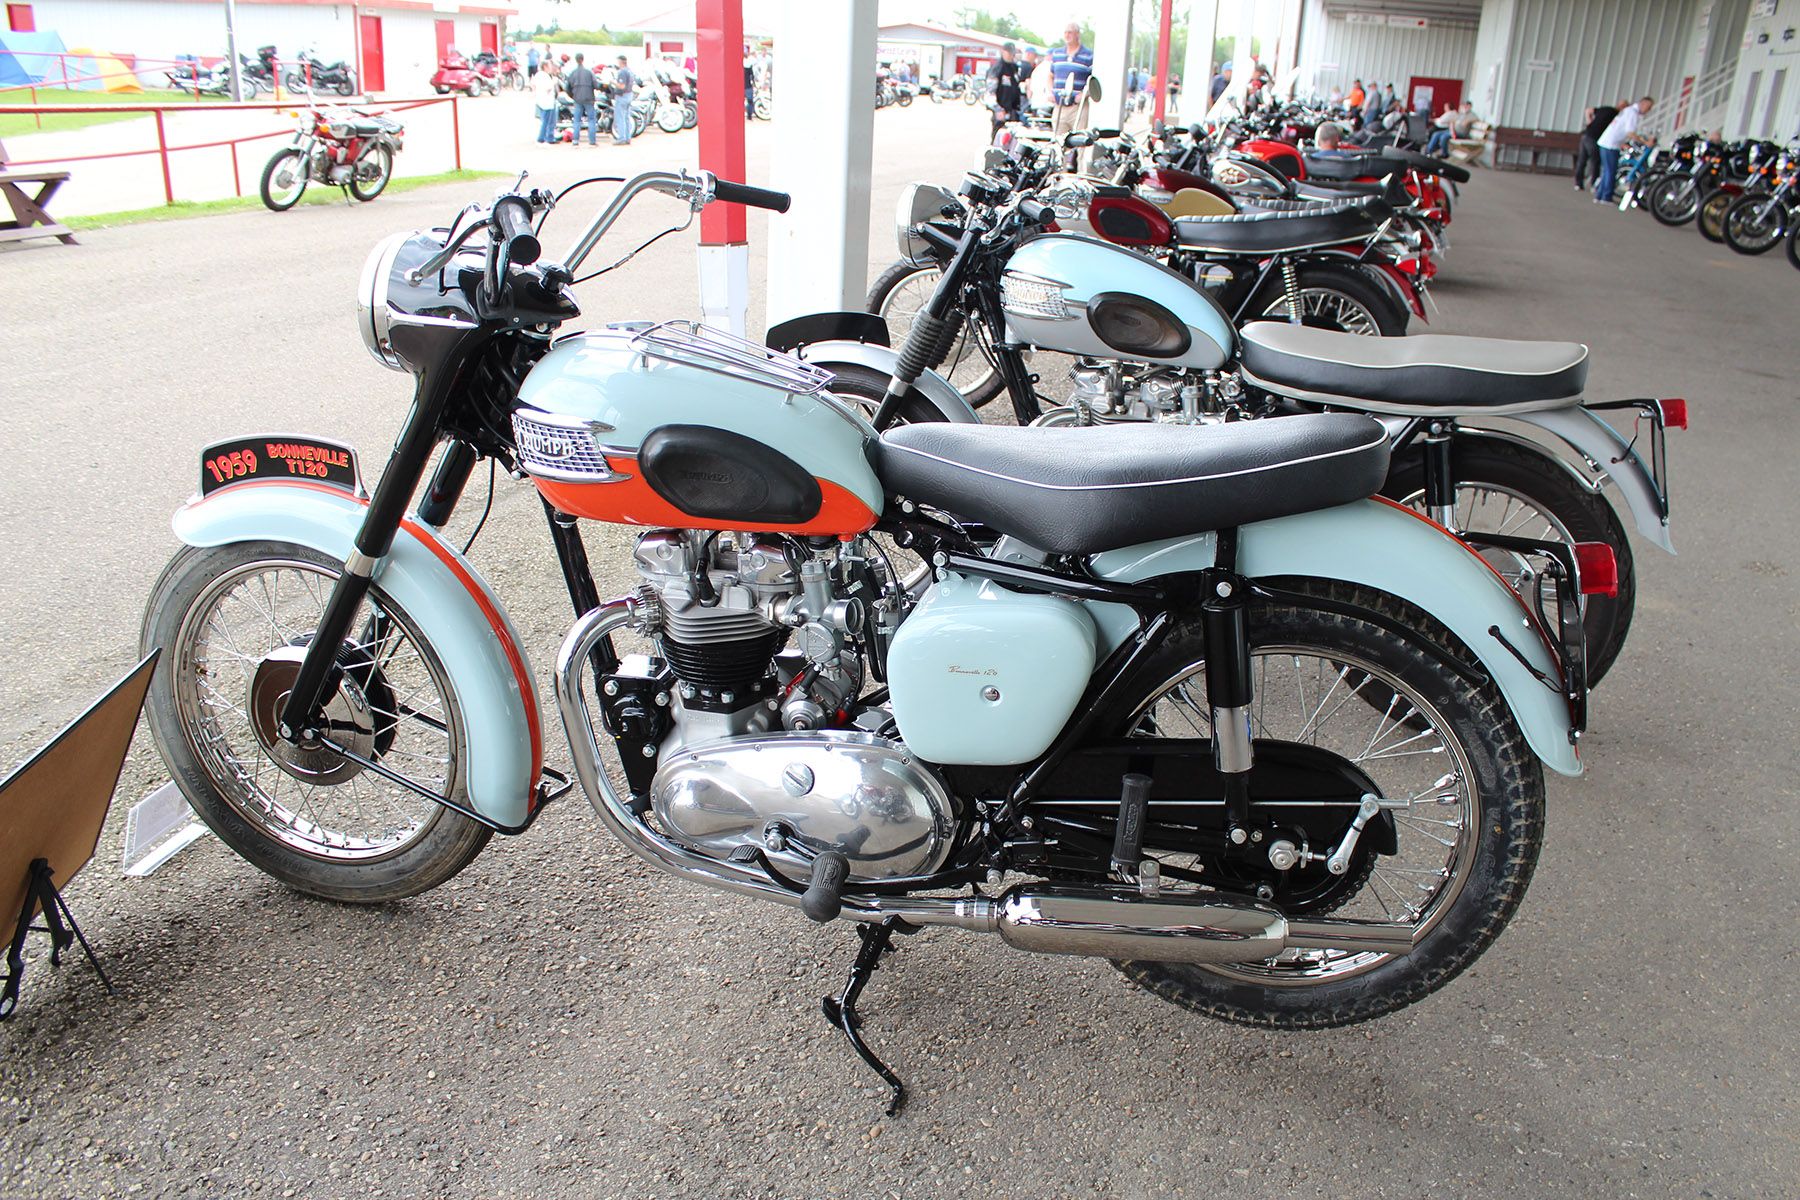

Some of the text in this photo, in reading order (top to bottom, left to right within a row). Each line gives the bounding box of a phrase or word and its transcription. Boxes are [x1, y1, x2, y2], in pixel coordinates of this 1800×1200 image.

[265, 443, 349, 468] BONNEVILLE
[516, 430, 576, 459] TRIUMPH
[206, 448, 258, 483] 1959
[285, 458, 328, 478] T120
